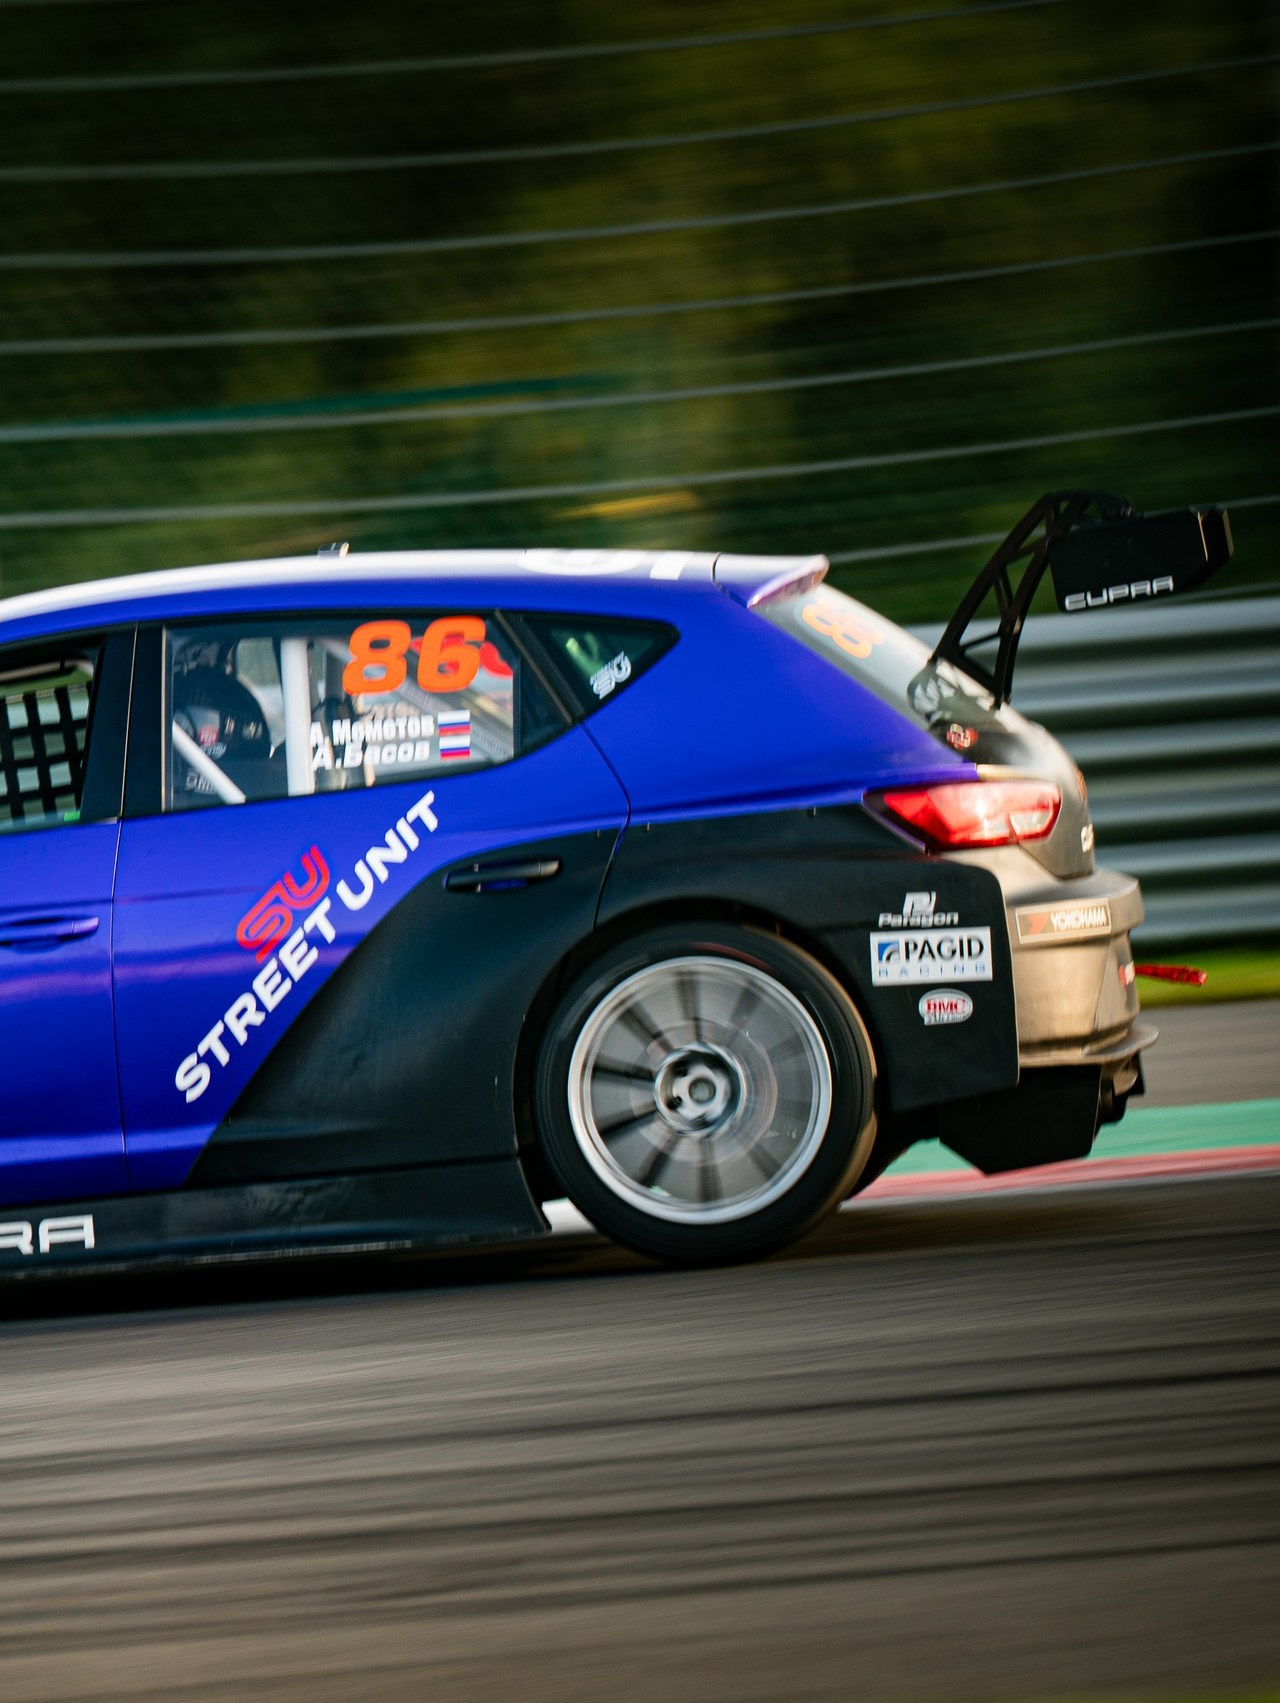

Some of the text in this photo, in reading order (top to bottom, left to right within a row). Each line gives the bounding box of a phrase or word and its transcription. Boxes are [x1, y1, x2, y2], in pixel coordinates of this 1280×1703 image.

[1065, 575, 1175, 612] CUPRA
[342, 615, 486, 696] 86
[1050, 904, 1108, 933] YOKOHAMA
[175, 790, 439, 1104] STREET UNIT
[903, 935, 985, 962] PAGID
